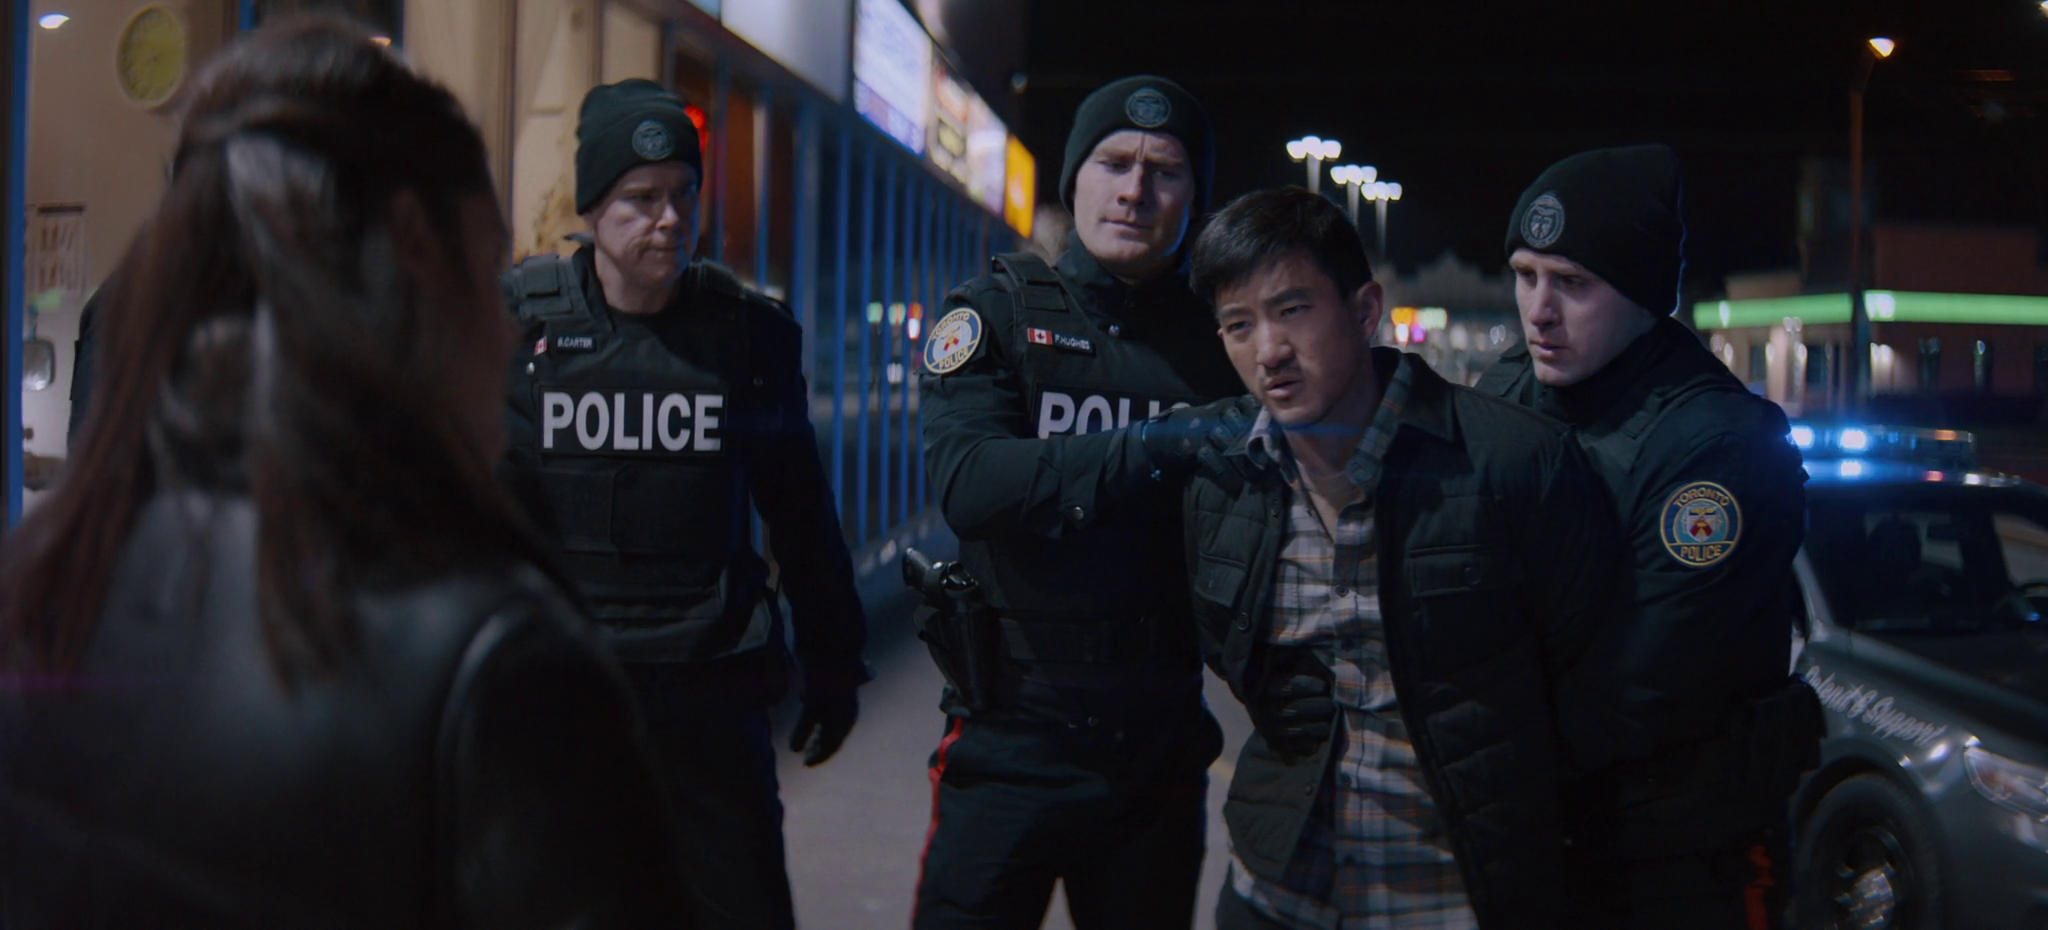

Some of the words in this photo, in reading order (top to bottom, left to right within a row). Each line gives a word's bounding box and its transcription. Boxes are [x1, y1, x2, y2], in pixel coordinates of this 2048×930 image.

[932, 312, 970, 340] TORONTO
[939, 347, 969, 370] POLICE
[543, 391, 724, 452] POLICE
[1037, 391, 1192, 440] POL
[1673, 487, 1731, 508] TORONTO
[1681, 545, 1722, 561] POLICE
[1861, 696, 1948, 748] Support
